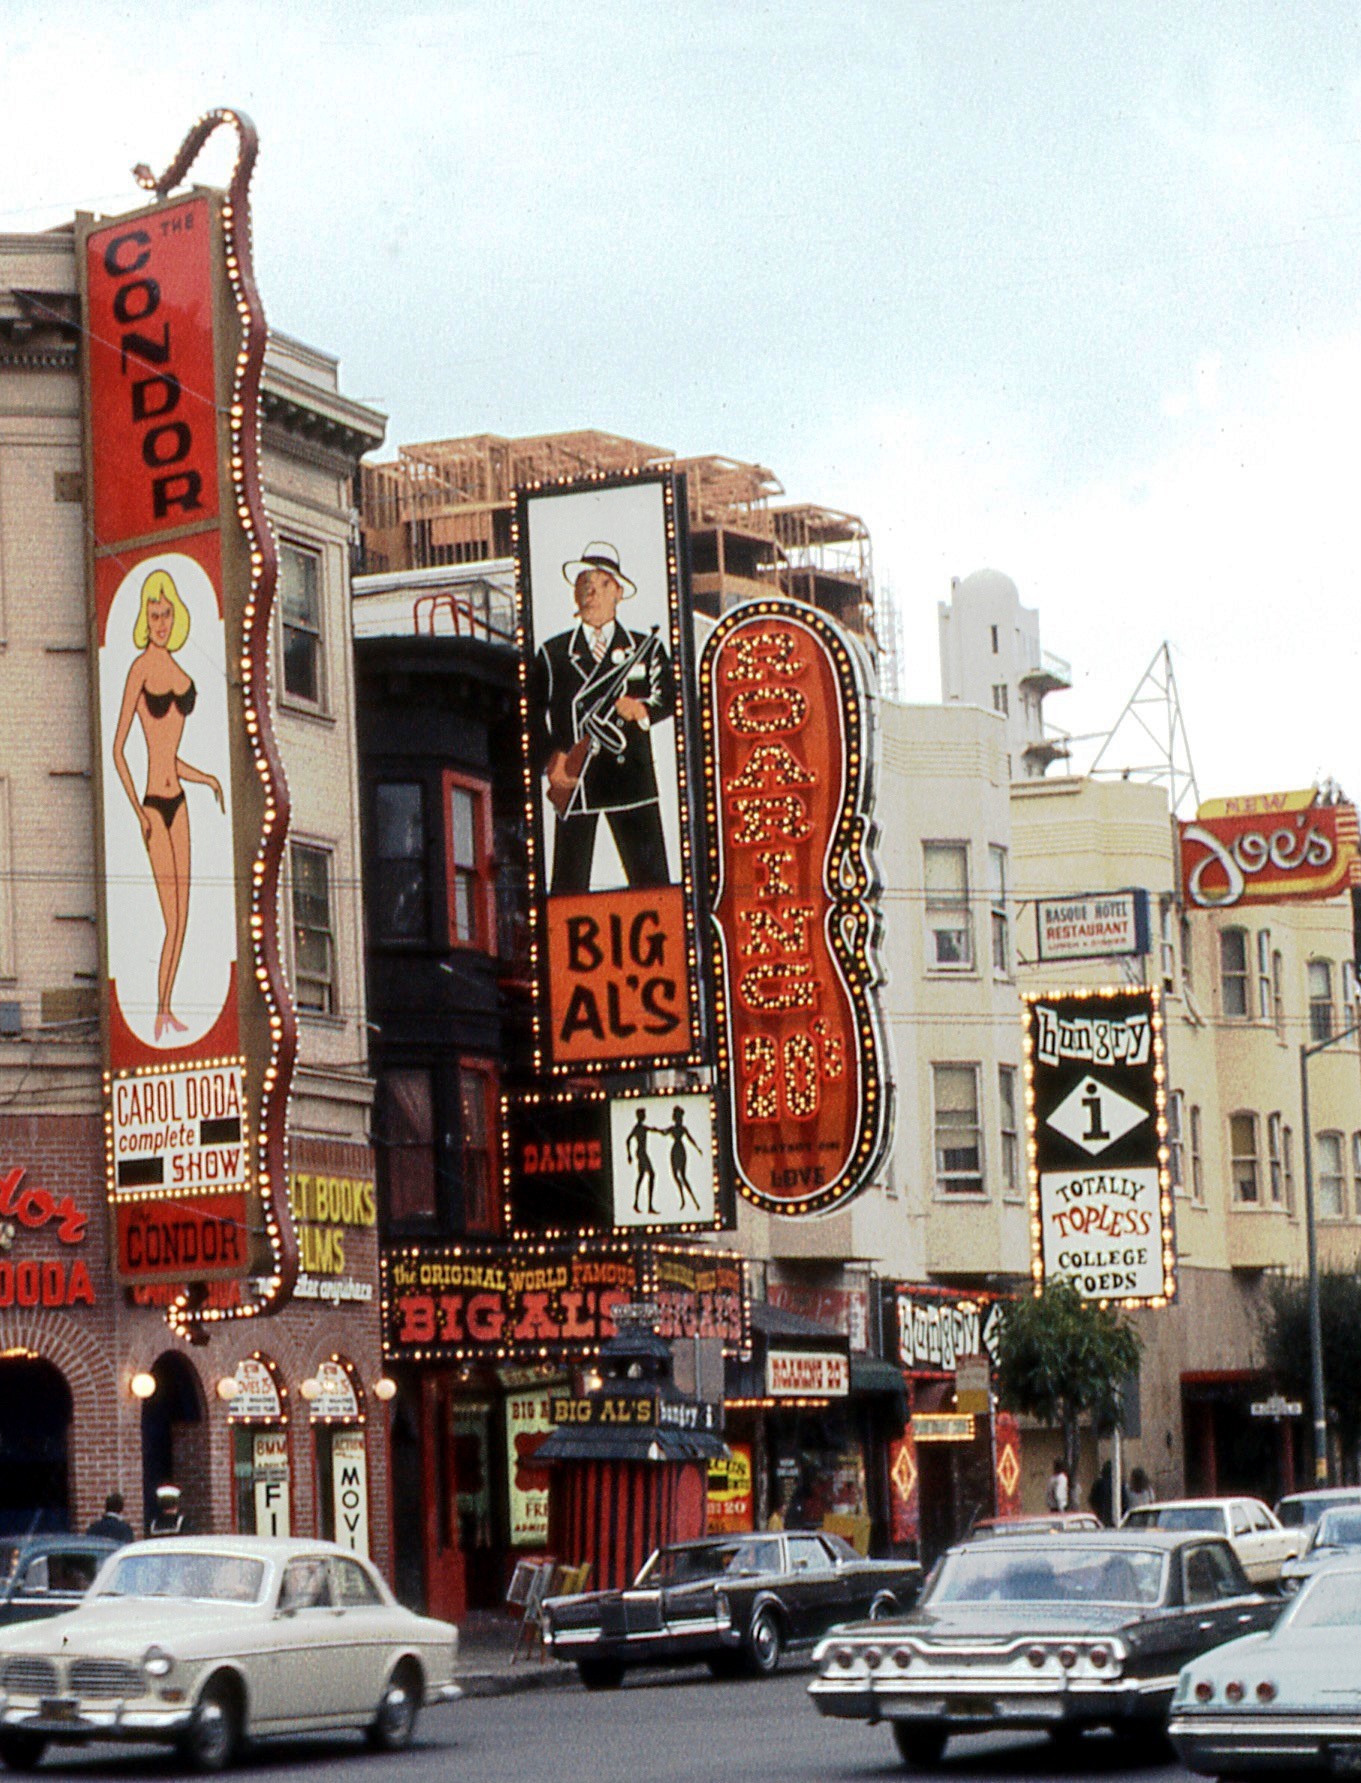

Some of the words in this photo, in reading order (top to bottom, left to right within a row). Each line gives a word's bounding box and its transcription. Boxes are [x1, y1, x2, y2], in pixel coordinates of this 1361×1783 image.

[160, 214, 194, 237] THE
[104, 230, 203, 519] CONDOR
[1225, 793, 1287, 815] NEW
[724, 632, 821, 1012] ROARING
[1181, 814, 1333, 908] Joe's
[1095, 901, 1127, 919] HOTEL
[566, 909, 667, 973] BIG
[1047, 921, 1128, 940] RESTAURANT
[559, 973, 680, 1043] AL'S
[1040, 1009, 1147, 1062] hungry
[117, 1079, 181, 1127] CAROL
[187, 1071, 240, 1120] DODA
[1081, 1083, 1111, 1141] i
[119, 1123, 195, 1155] complete
[172, 1149, 240, 1183] SHOW
[523, 1141, 602, 1174] DANCE
[315, 1177, 377, 1226] BOOKS
[1055, 1175, 1146, 1203] TOTALLY
[1052, 1207, 1154, 1239] TOPLESS
[127, 1218, 239, 1267] CONDOR
[1058, 1248, 1148, 1268] COLLEGE
[394, 1266, 417, 1286] the
[420, 1263, 506, 1291] ORIGINAL
[509, 1265, 568, 1291] WORLD
[571, 1261, 636, 1288] FAMOUS
[1071, 1272, 1138, 1293] COEDS
[400, 1294, 506, 1342] BIG
[512, 1401, 535, 1419] BIG
[555, 1400, 592, 1423] BIG
[600, 1400, 652, 1422] AL'S
